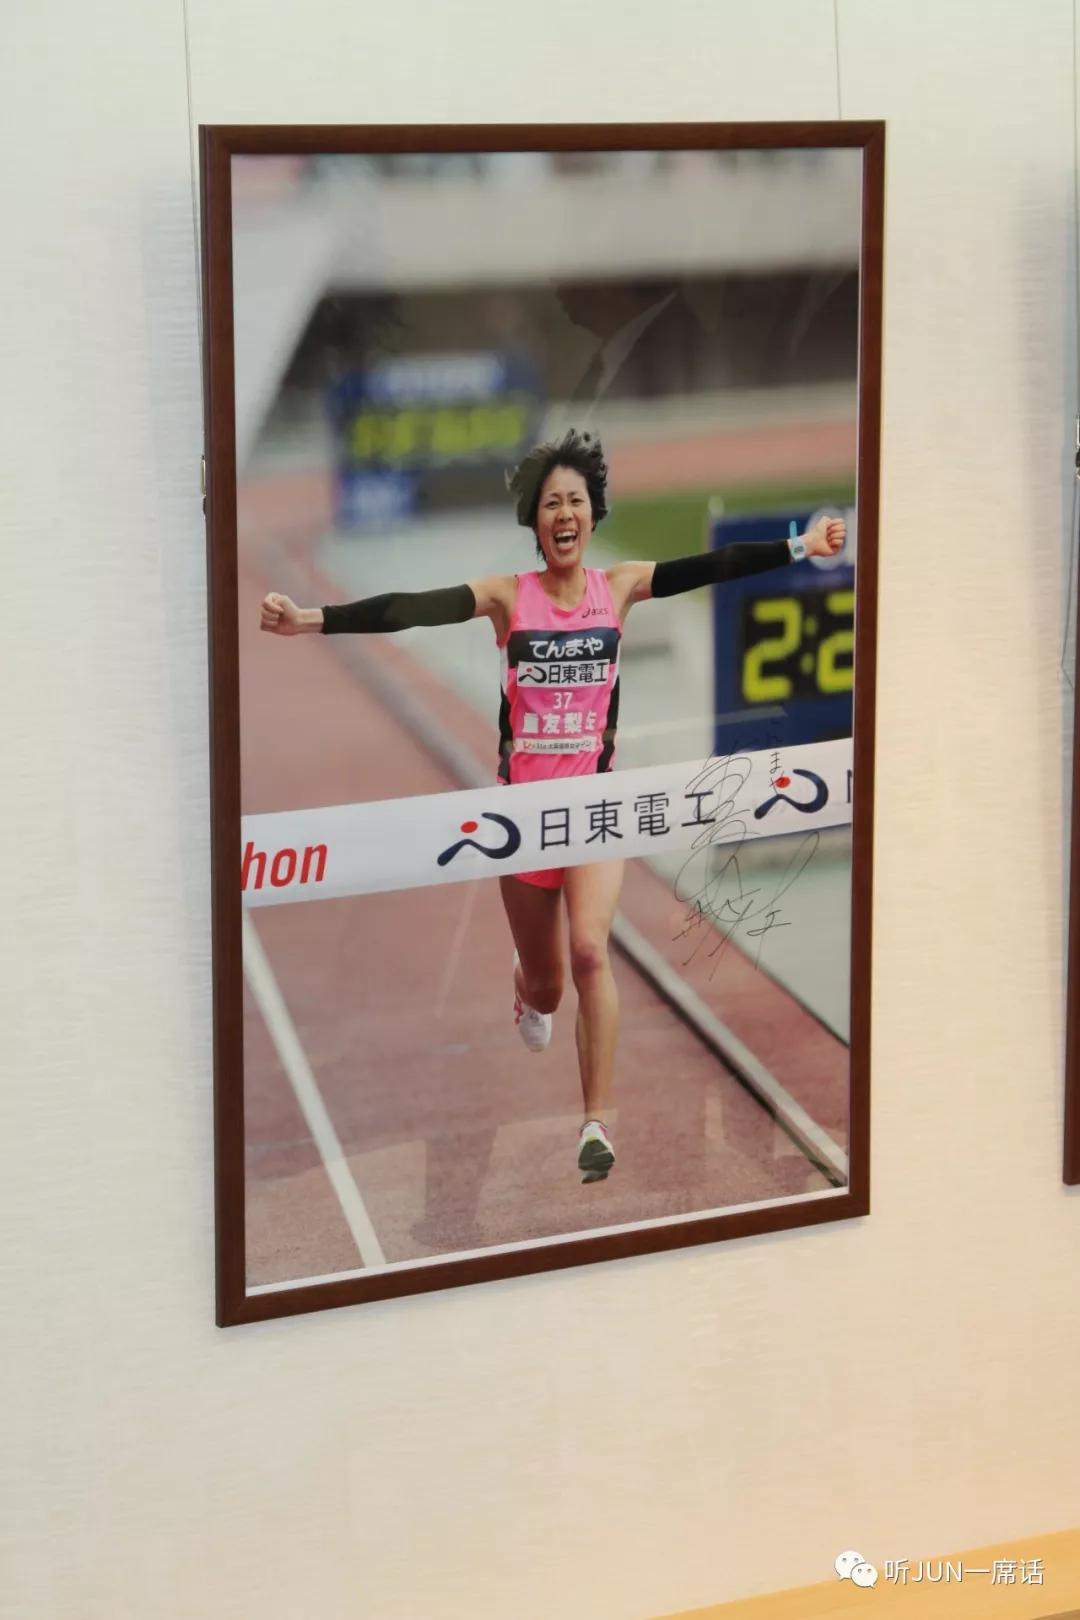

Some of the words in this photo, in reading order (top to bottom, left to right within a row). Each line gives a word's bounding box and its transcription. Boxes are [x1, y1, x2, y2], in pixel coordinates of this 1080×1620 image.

[529, 637, 604, 659] てんまや
[548, 663, 608, 684] 日東電工
[553, 692, 573, 709] 37
[540, 790, 716, 850] 日東電工
[241, 841, 328, 891] hon
